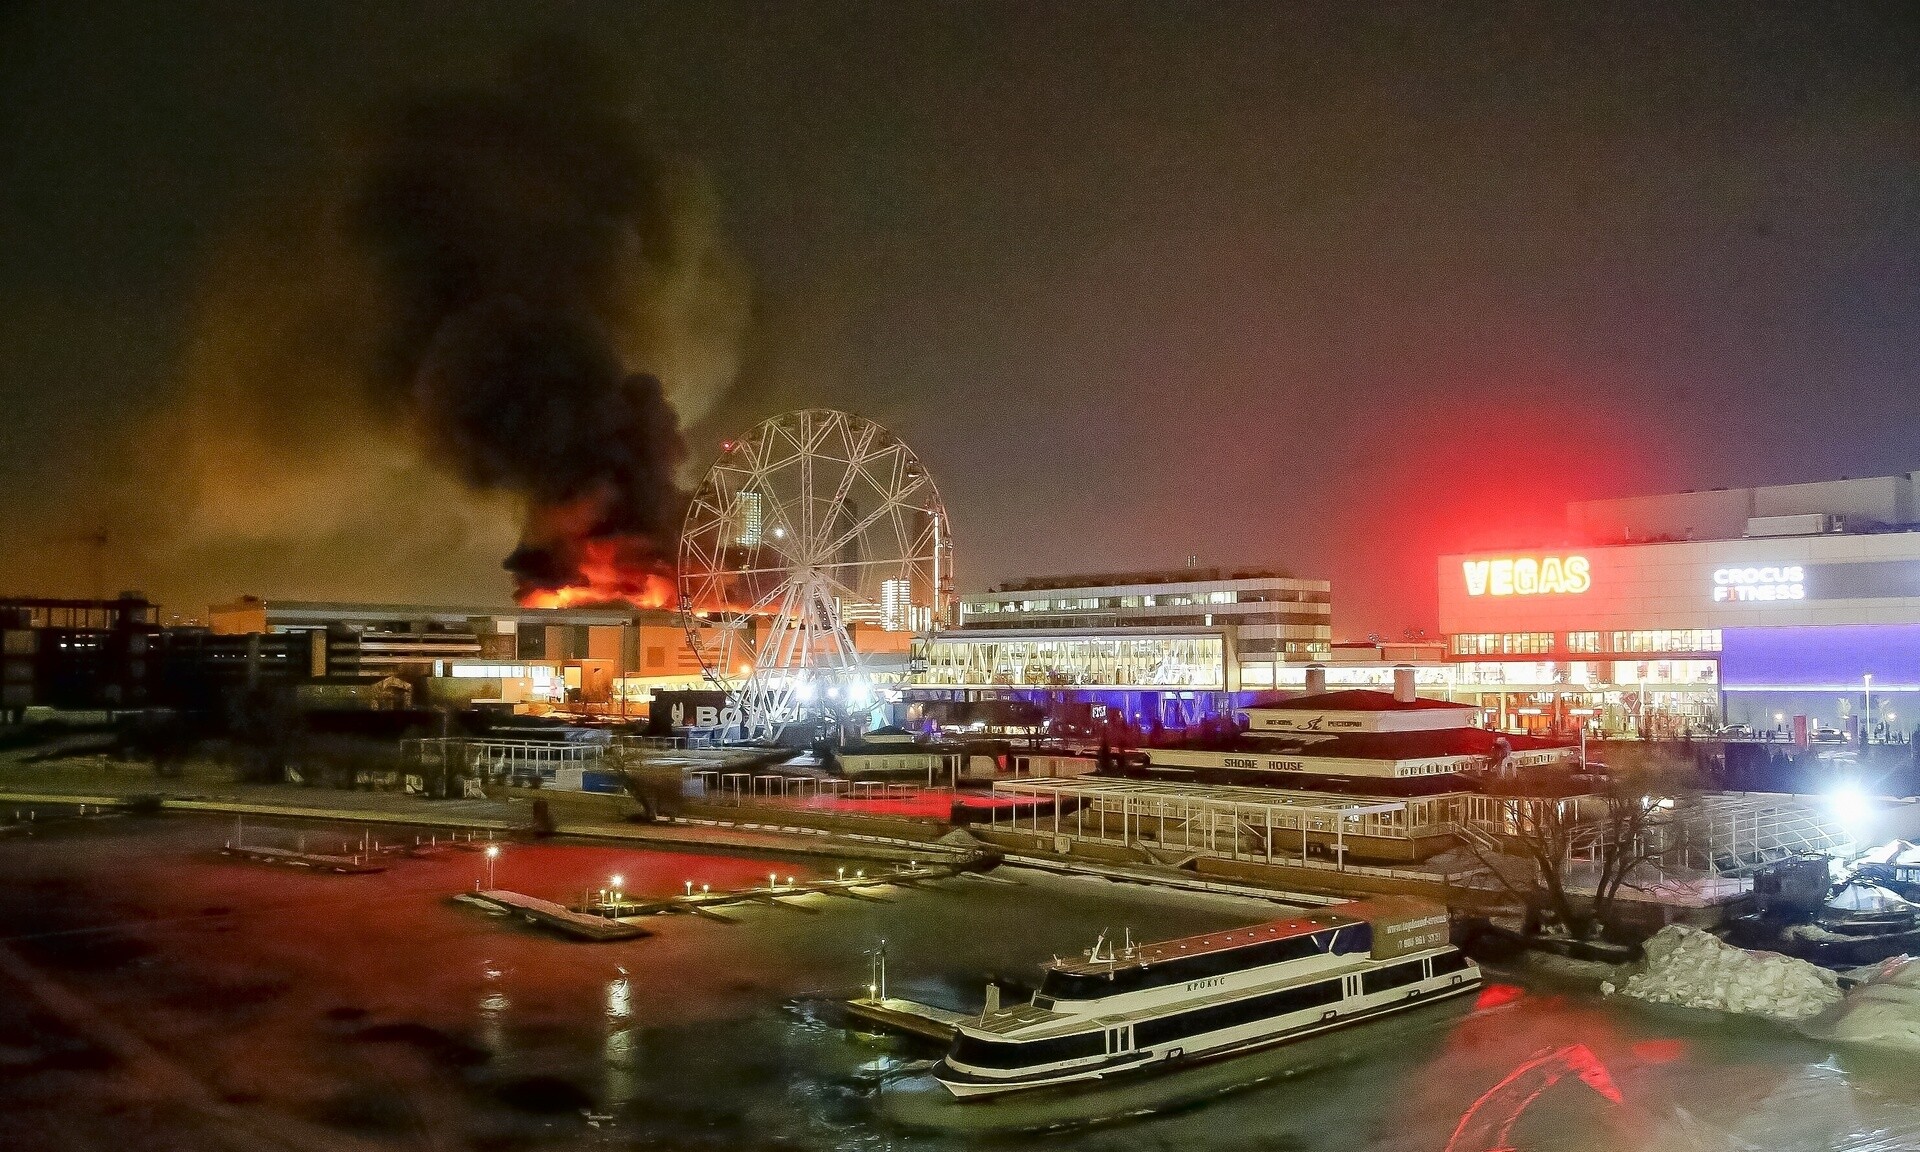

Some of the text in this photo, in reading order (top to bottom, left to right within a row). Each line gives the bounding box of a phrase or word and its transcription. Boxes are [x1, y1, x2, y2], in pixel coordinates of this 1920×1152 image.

[1463, 556, 1591, 596] VEGAS
[1713, 566, 1804, 585] CROCUS
[1224, 758, 1304, 771] SHORE HOUSE
[1187, 977, 1225, 992] КРОКУС
